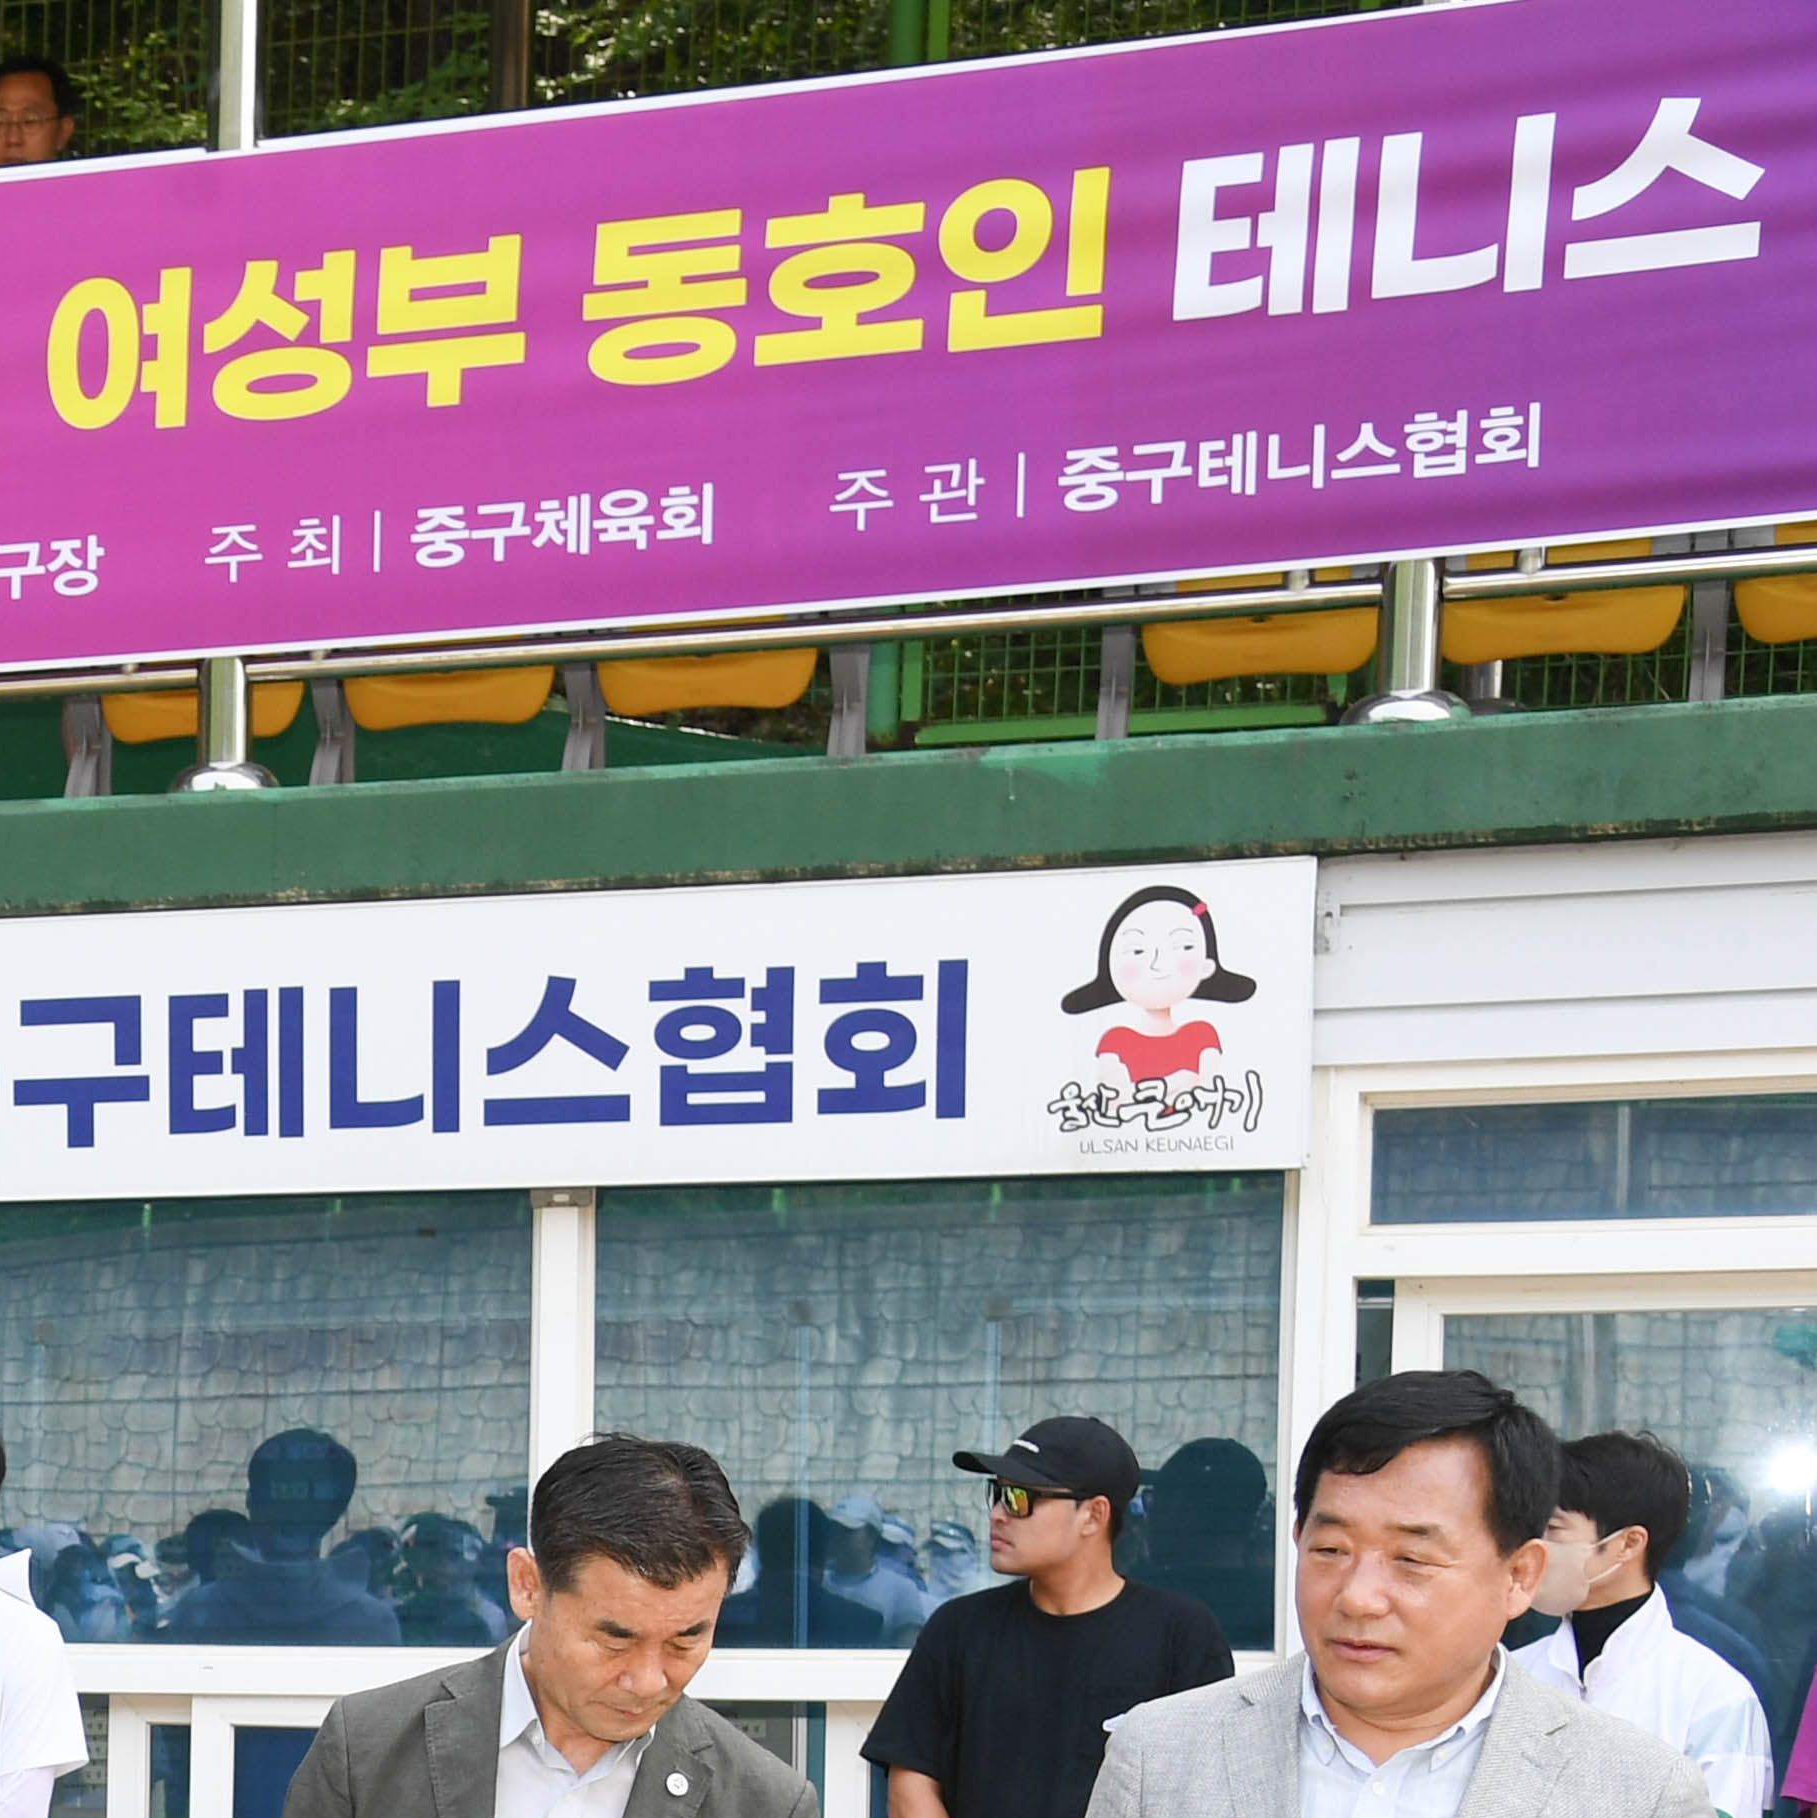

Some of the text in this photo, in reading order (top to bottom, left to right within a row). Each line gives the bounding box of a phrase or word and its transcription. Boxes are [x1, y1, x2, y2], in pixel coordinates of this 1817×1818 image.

[47, 234, 525, 429] 여성부
[582, 166, 1111, 386] 동호인
[1173, 97, 1765, 321] 테니스
[1058, 402, 1541, 512] 중구테니스협회
[410, 482, 714, 568] 중구체육회
[1079, 1135, 1234, 1154] ULSAN KEUNAEGI
